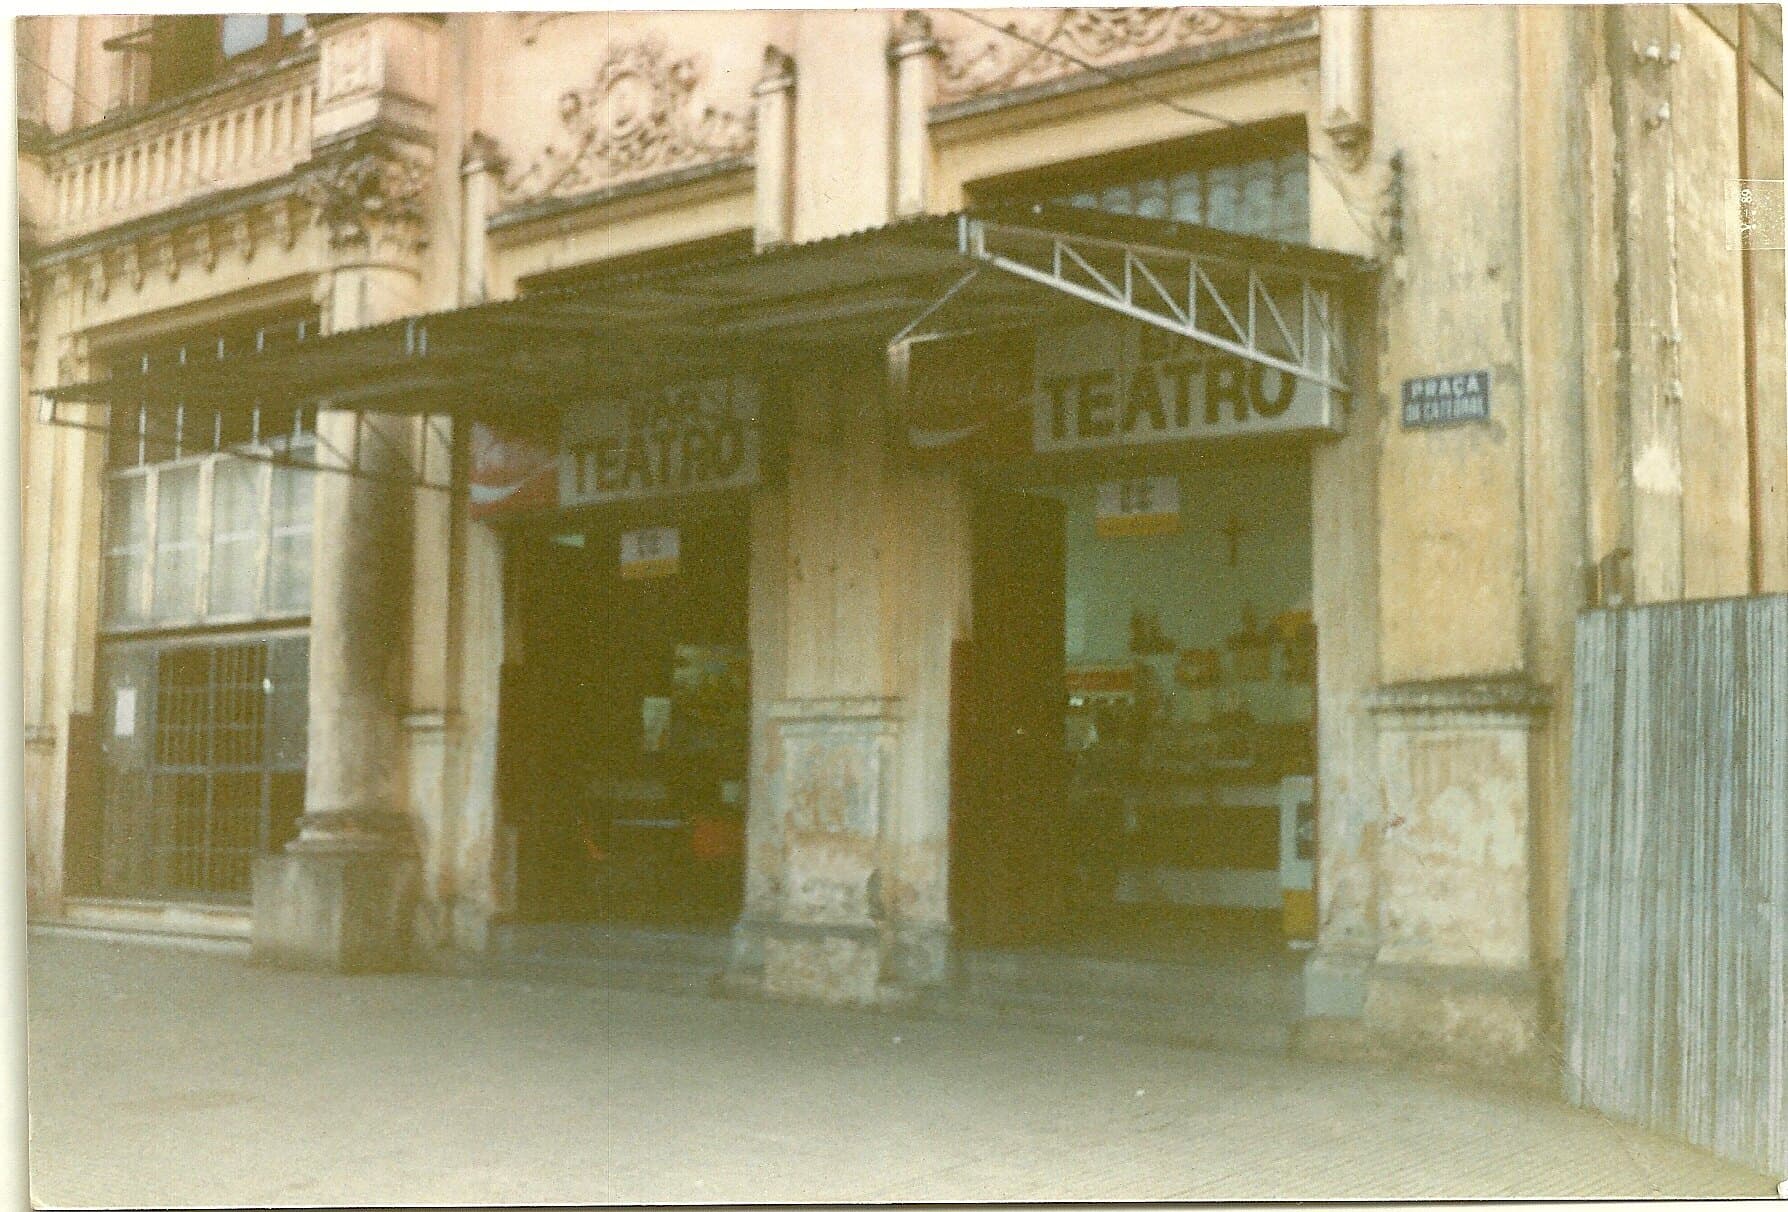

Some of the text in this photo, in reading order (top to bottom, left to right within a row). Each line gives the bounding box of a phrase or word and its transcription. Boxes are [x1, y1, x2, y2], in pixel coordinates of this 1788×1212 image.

[1041, 345, 1298, 439] TEATRO
[1411, 375, 1480, 399] PRAÇA
[567, 420, 744, 493] TEATRO
